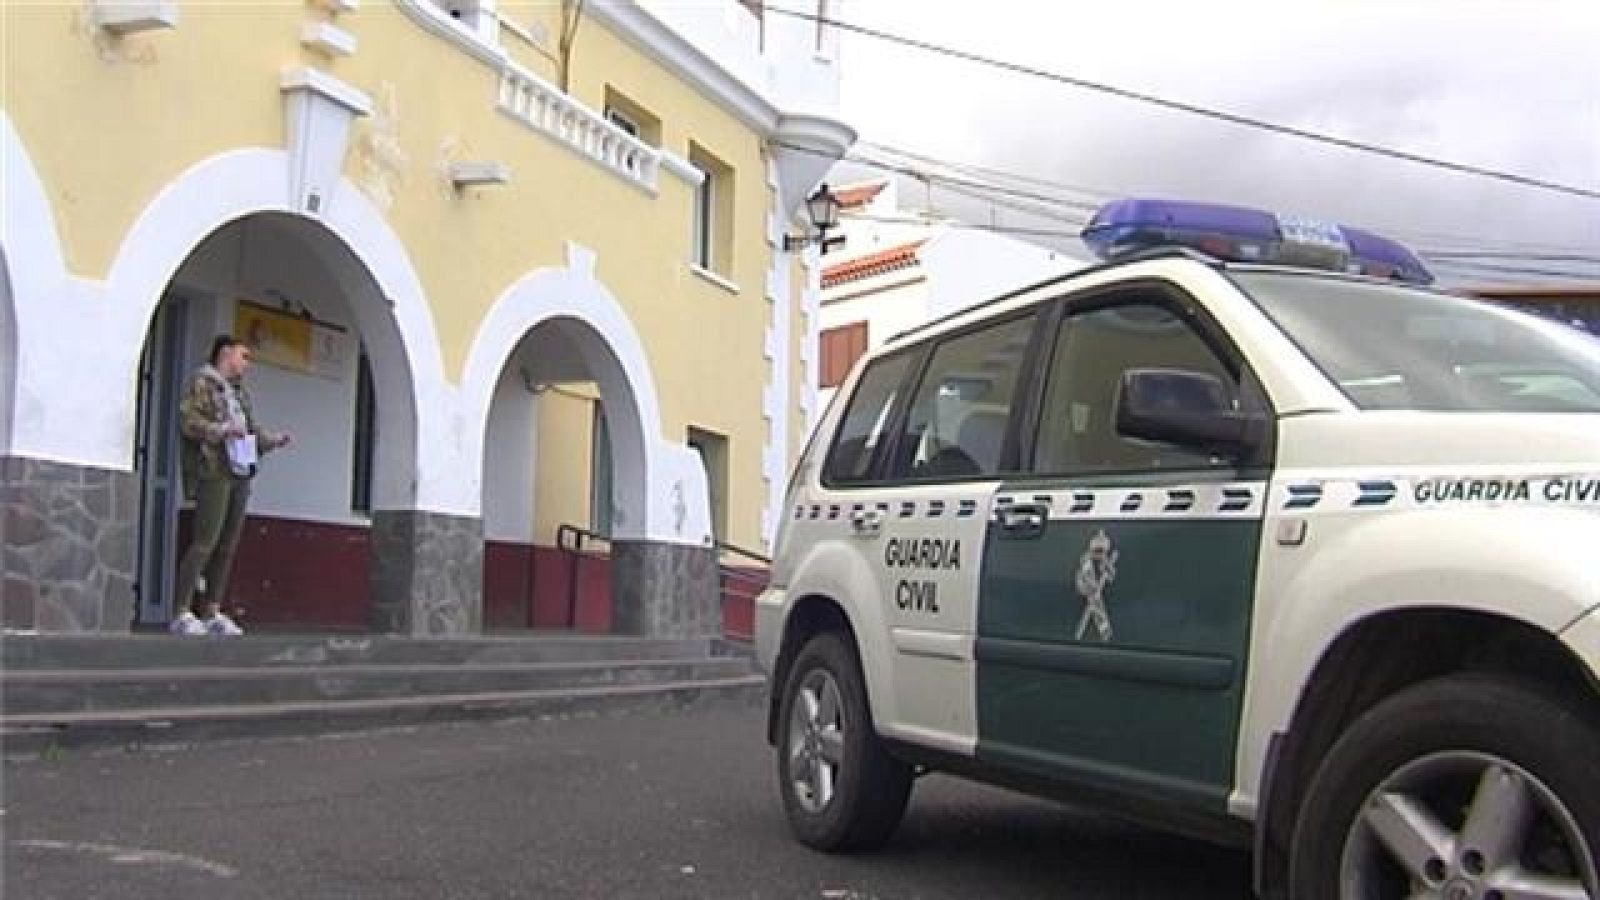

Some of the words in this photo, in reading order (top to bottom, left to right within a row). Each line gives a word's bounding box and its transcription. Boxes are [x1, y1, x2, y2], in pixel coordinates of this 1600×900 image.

[1414, 479, 1529, 502] GUARDIA
[885, 537, 961, 570] GUARDIA
[896, 579, 939, 613] CIVIL
